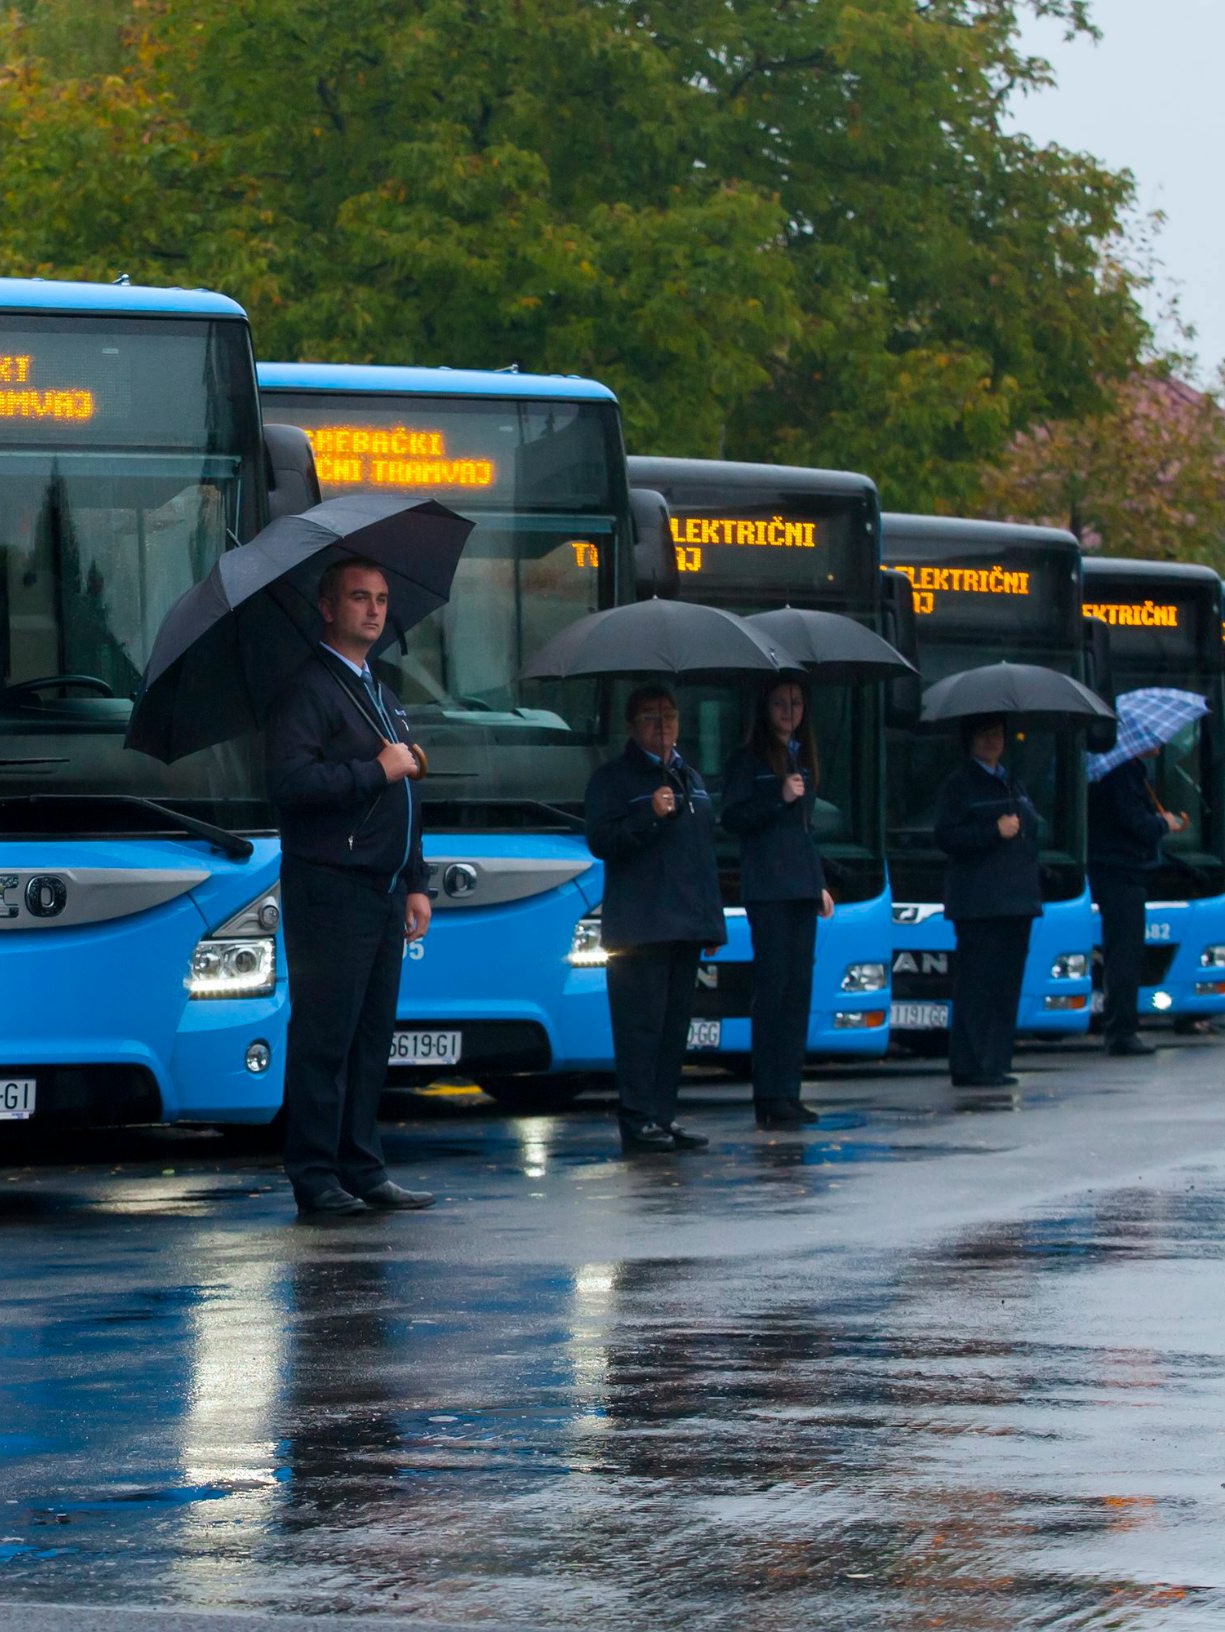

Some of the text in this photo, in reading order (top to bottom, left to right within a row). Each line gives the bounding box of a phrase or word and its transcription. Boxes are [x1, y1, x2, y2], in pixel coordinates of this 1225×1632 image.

[303, 424, 444, 457] REBAČKI
[371, 457, 494, 486] TRAMVAJ
[670, 516, 816, 547] LEKTRIČNI
[893, 565, 1030, 595] LEKTRIČNI
[1081, 600, 1178, 627] EKTRIČNI
[892, 952, 948, 974] AN
